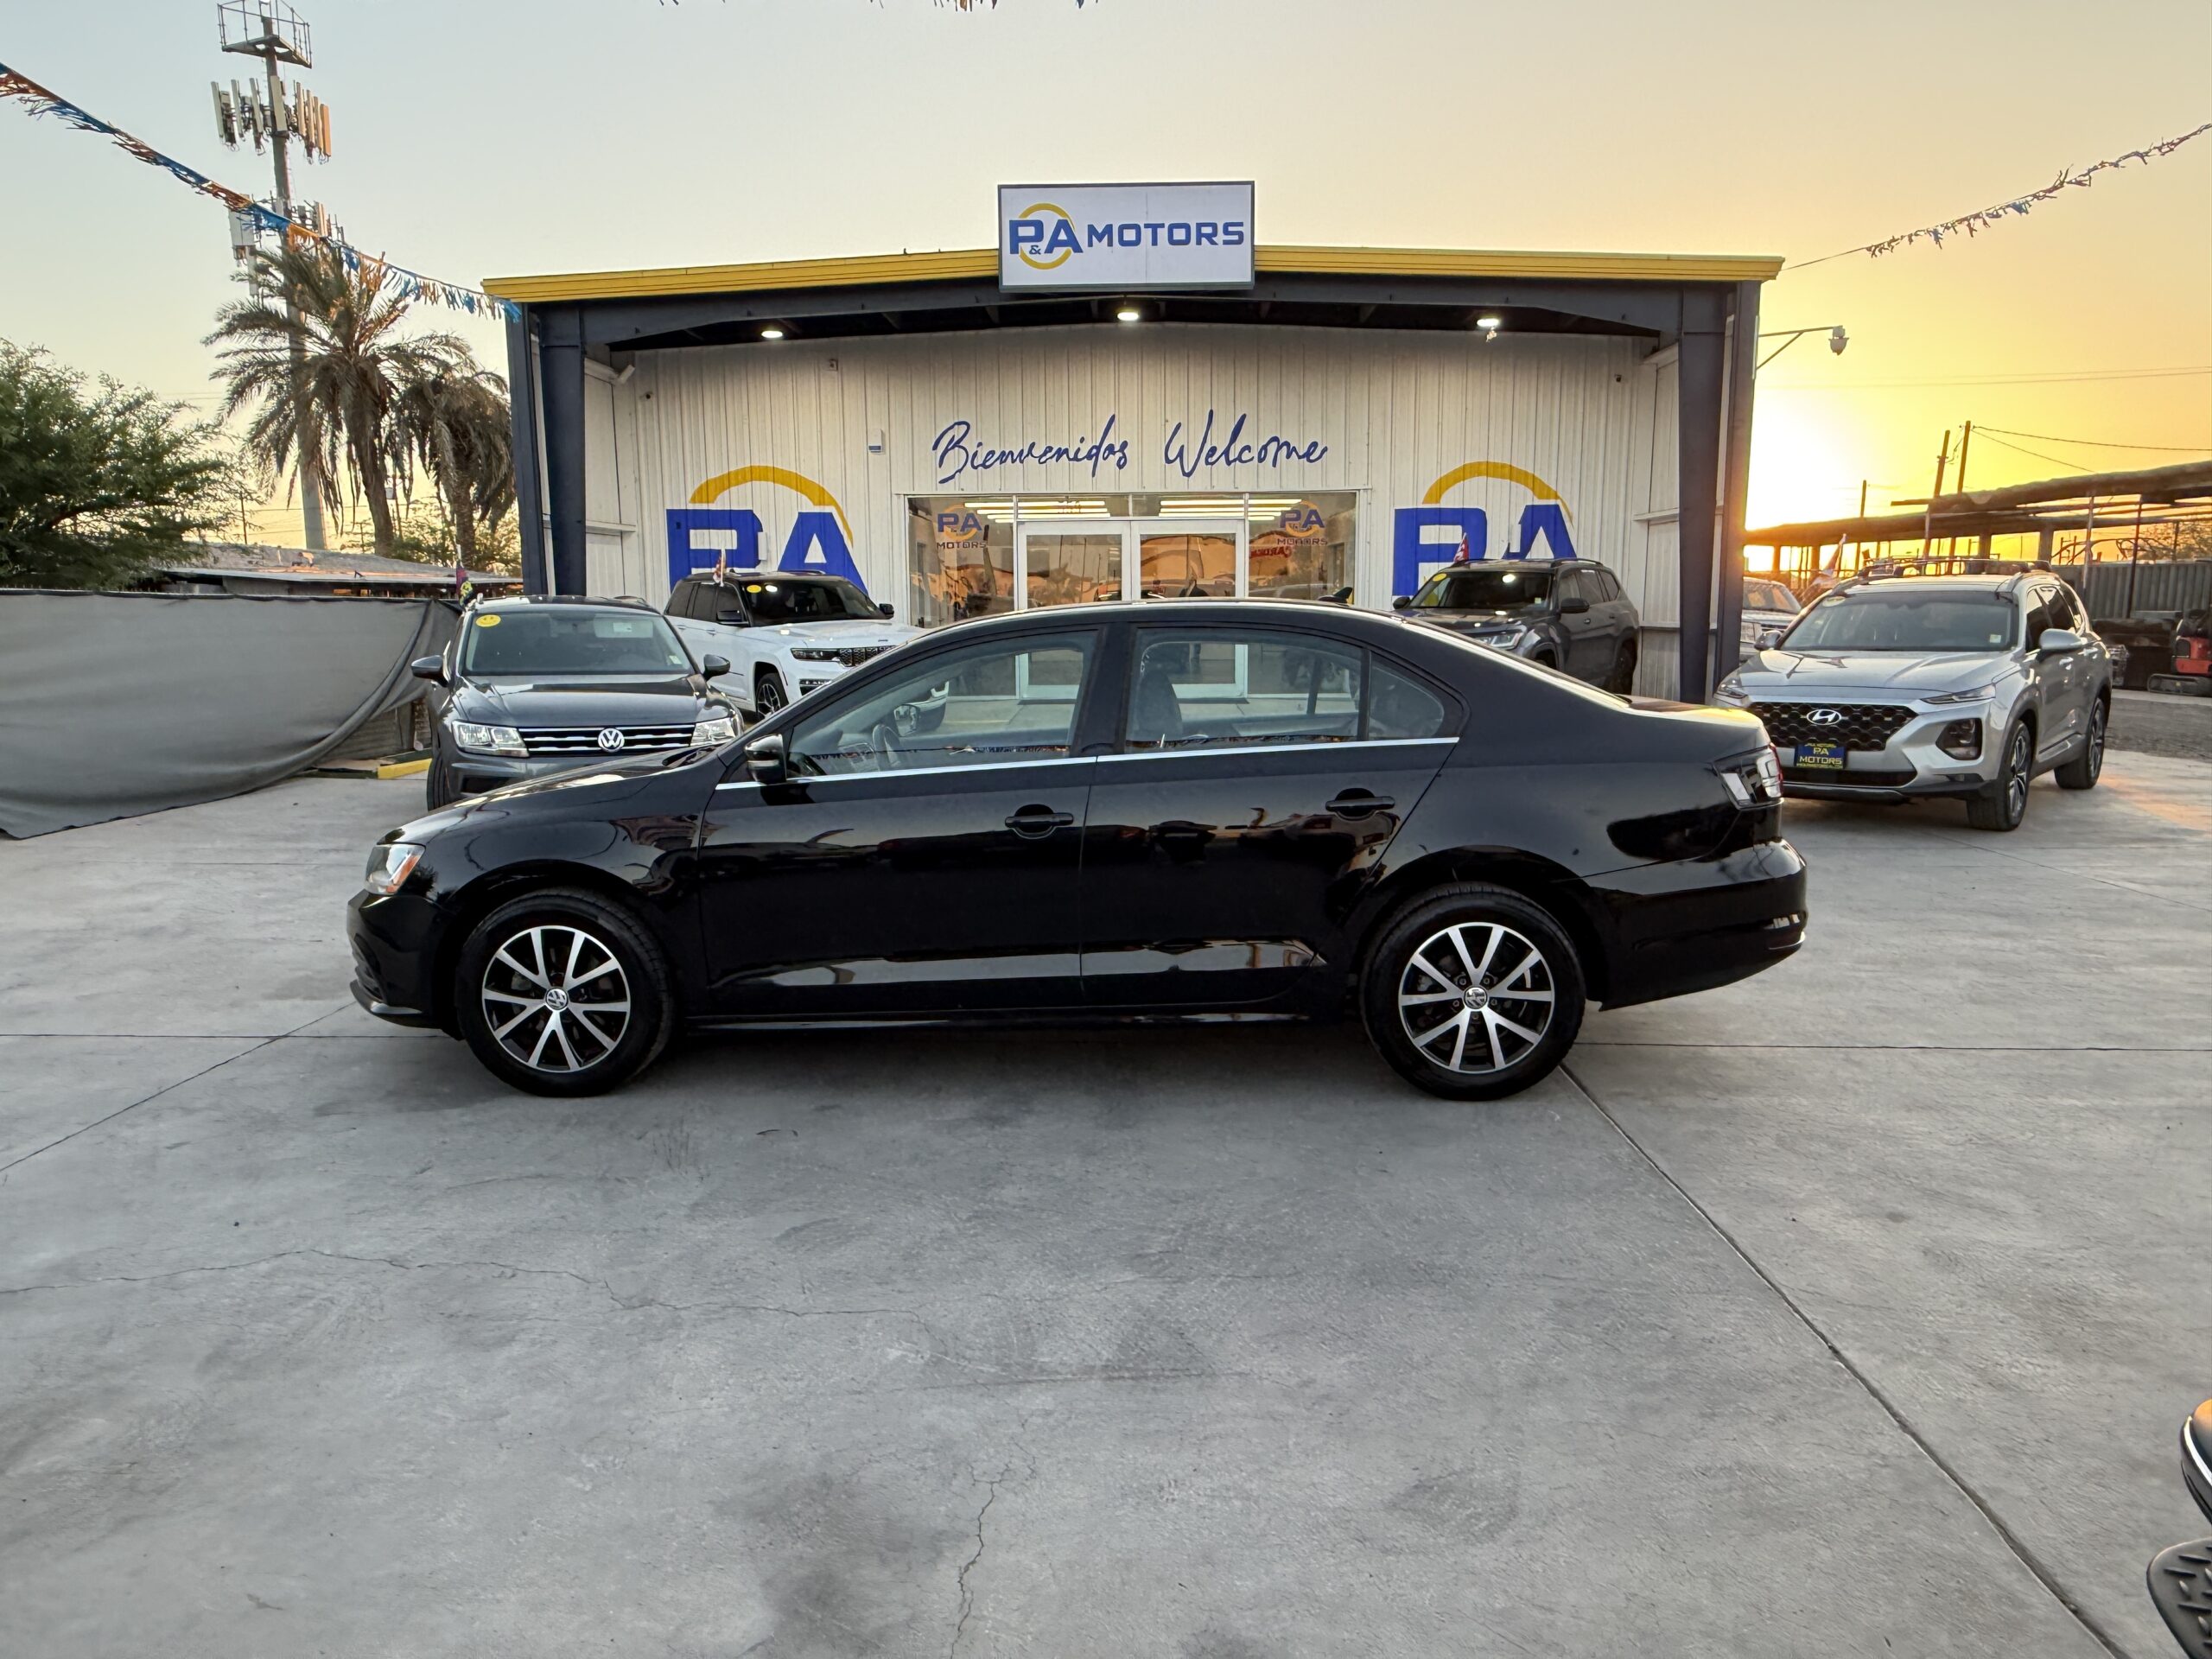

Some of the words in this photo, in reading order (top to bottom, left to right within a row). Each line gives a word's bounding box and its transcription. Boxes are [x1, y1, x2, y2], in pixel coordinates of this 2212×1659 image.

[1087, 222, 1244, 247] MOTORS
[932, 414, 1129, 484] Bienvenidos
[1164, 409, 1328, 478] Welcome
[1799, 756, 1843, 765] MOTORS
